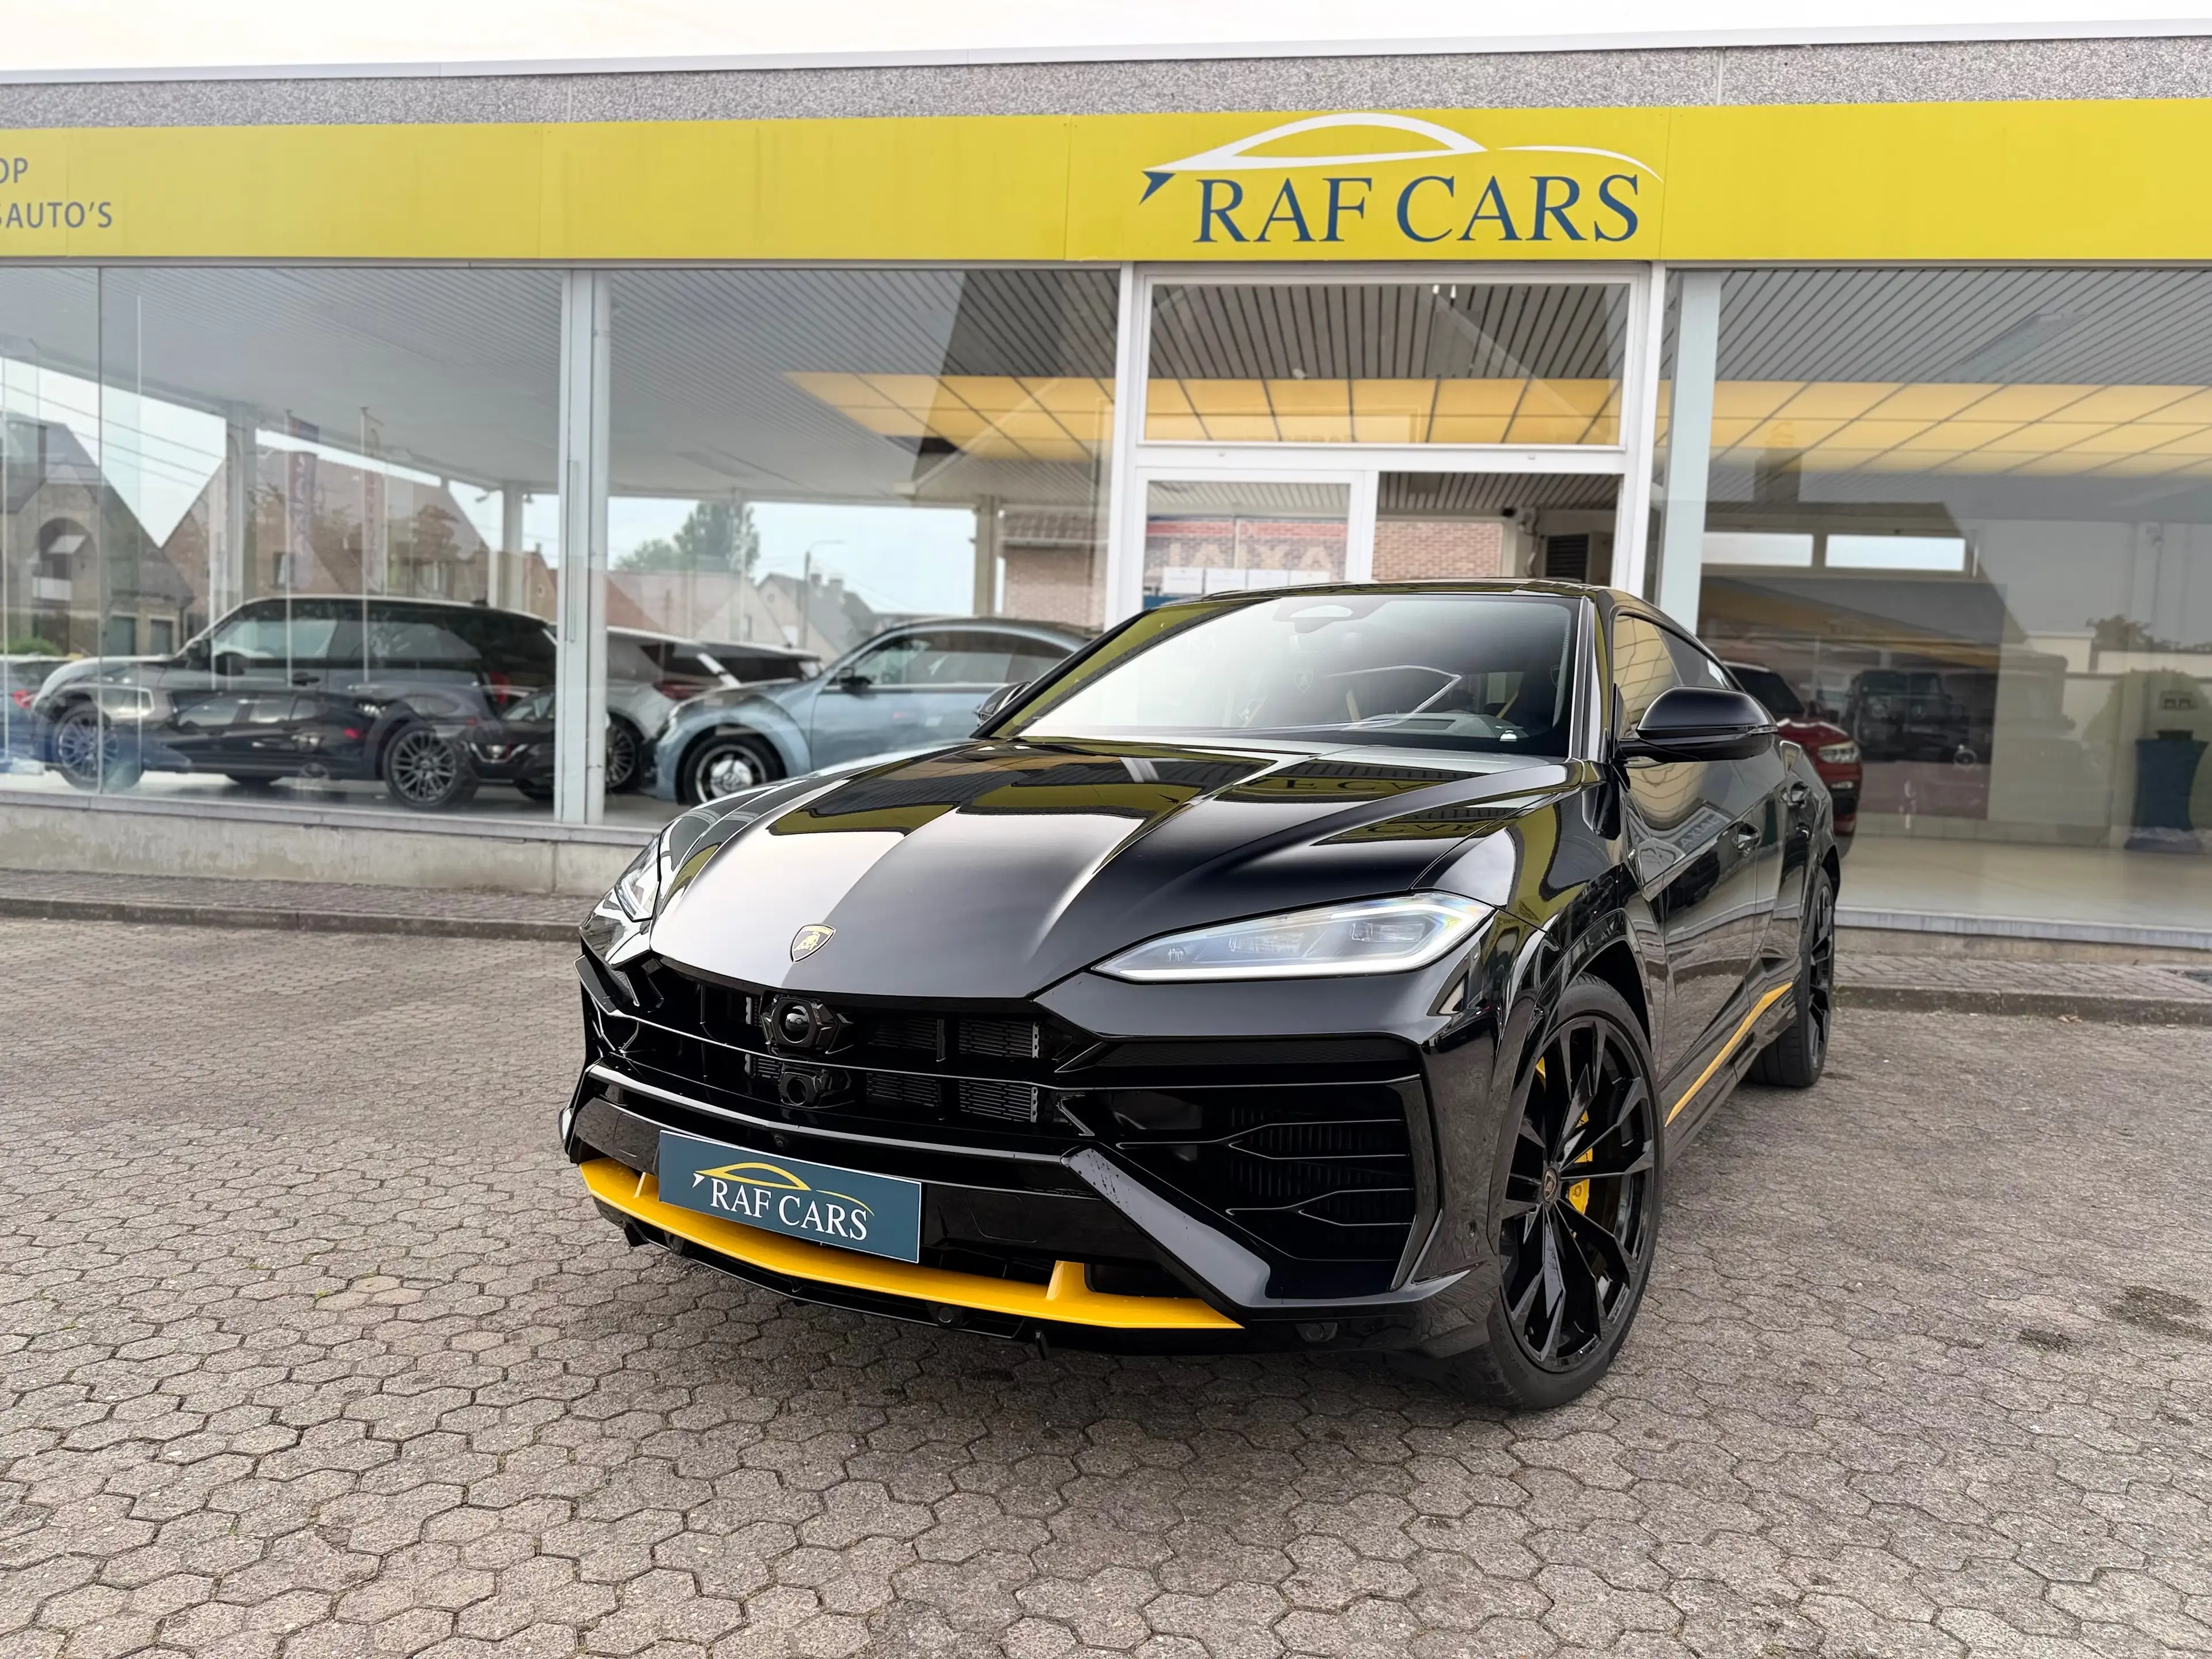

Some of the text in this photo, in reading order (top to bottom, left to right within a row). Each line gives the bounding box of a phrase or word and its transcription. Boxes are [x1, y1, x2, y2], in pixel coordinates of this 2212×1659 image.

[0, 201, 112, 228] AUTO'S
[1192, 174, 1639, 243] RAF CARS
[710, 1178, 868, 1241] RAF CARS
